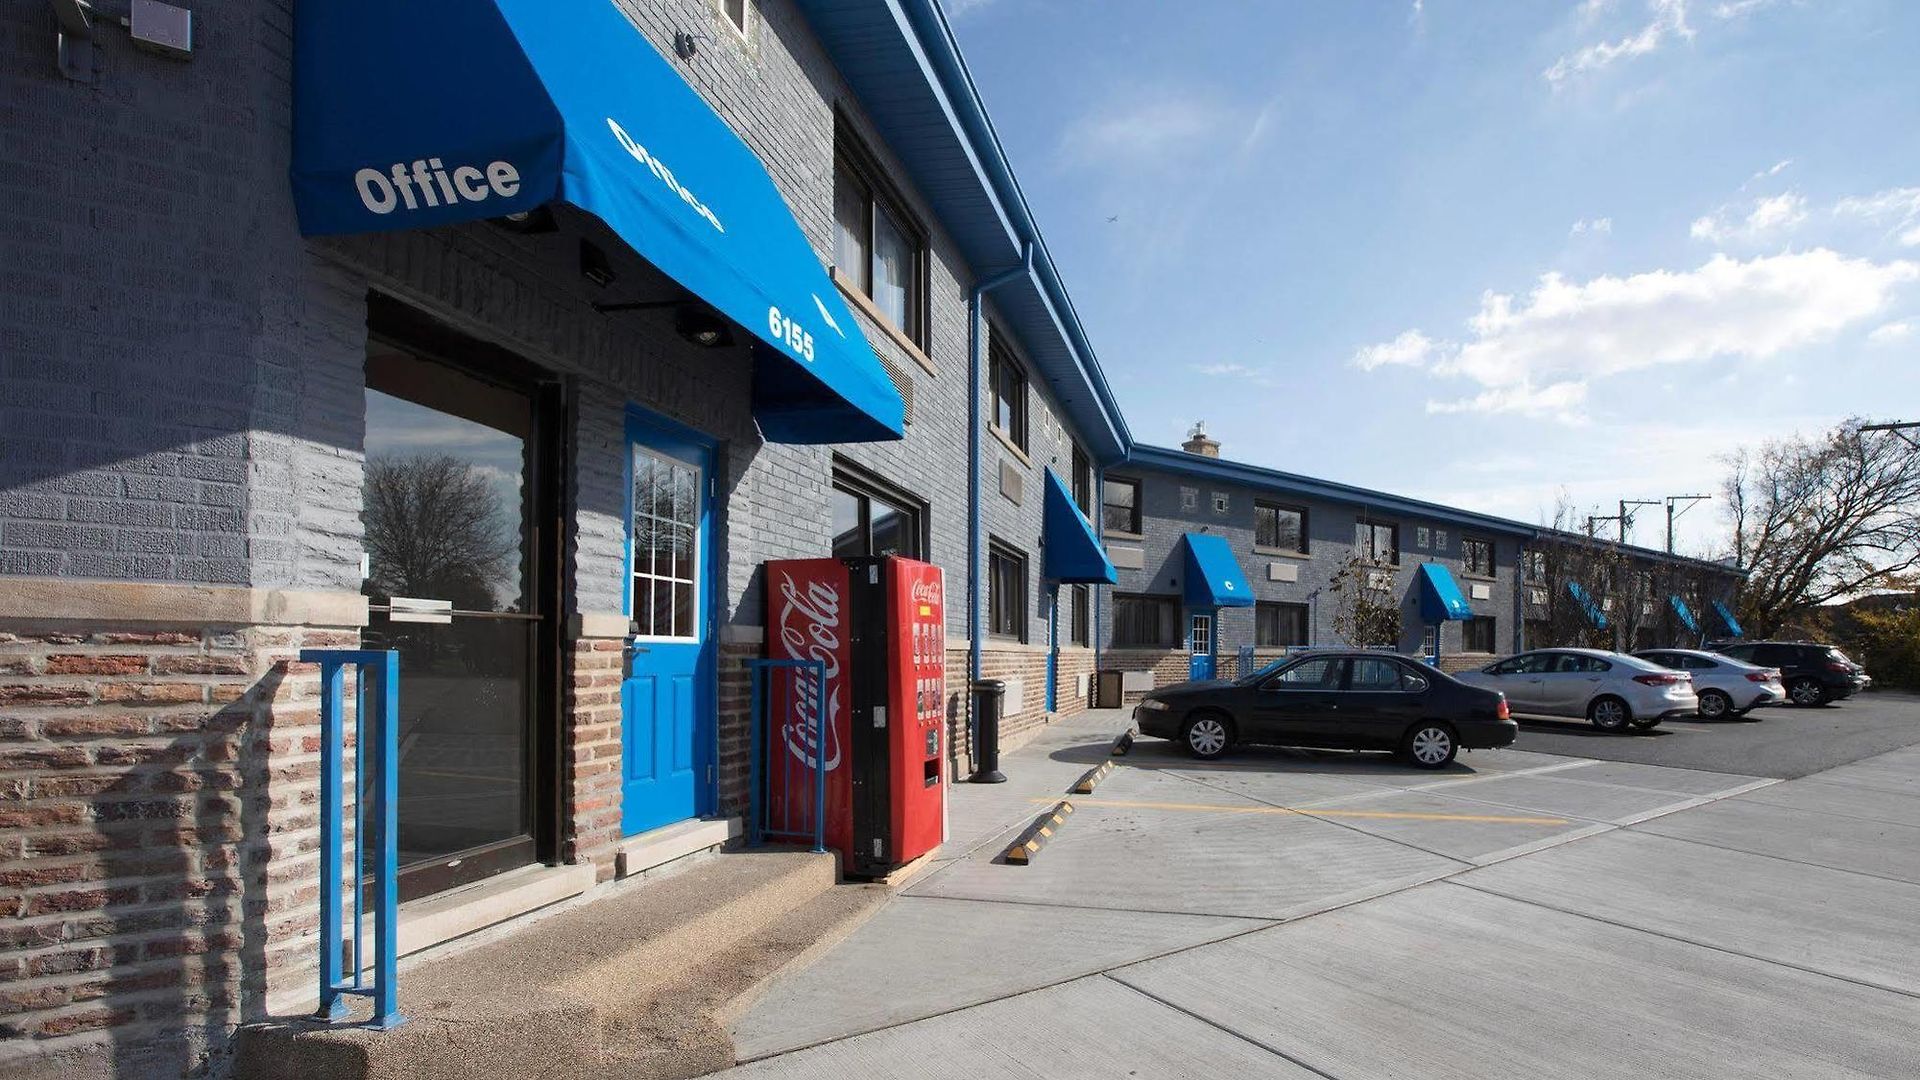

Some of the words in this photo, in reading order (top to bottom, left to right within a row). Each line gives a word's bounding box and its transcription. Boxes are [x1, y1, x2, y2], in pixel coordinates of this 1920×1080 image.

[354, 157, 521, 215] Office
[607, 117, 725, 233] Office
[768, 305, 815, 363] 6155
